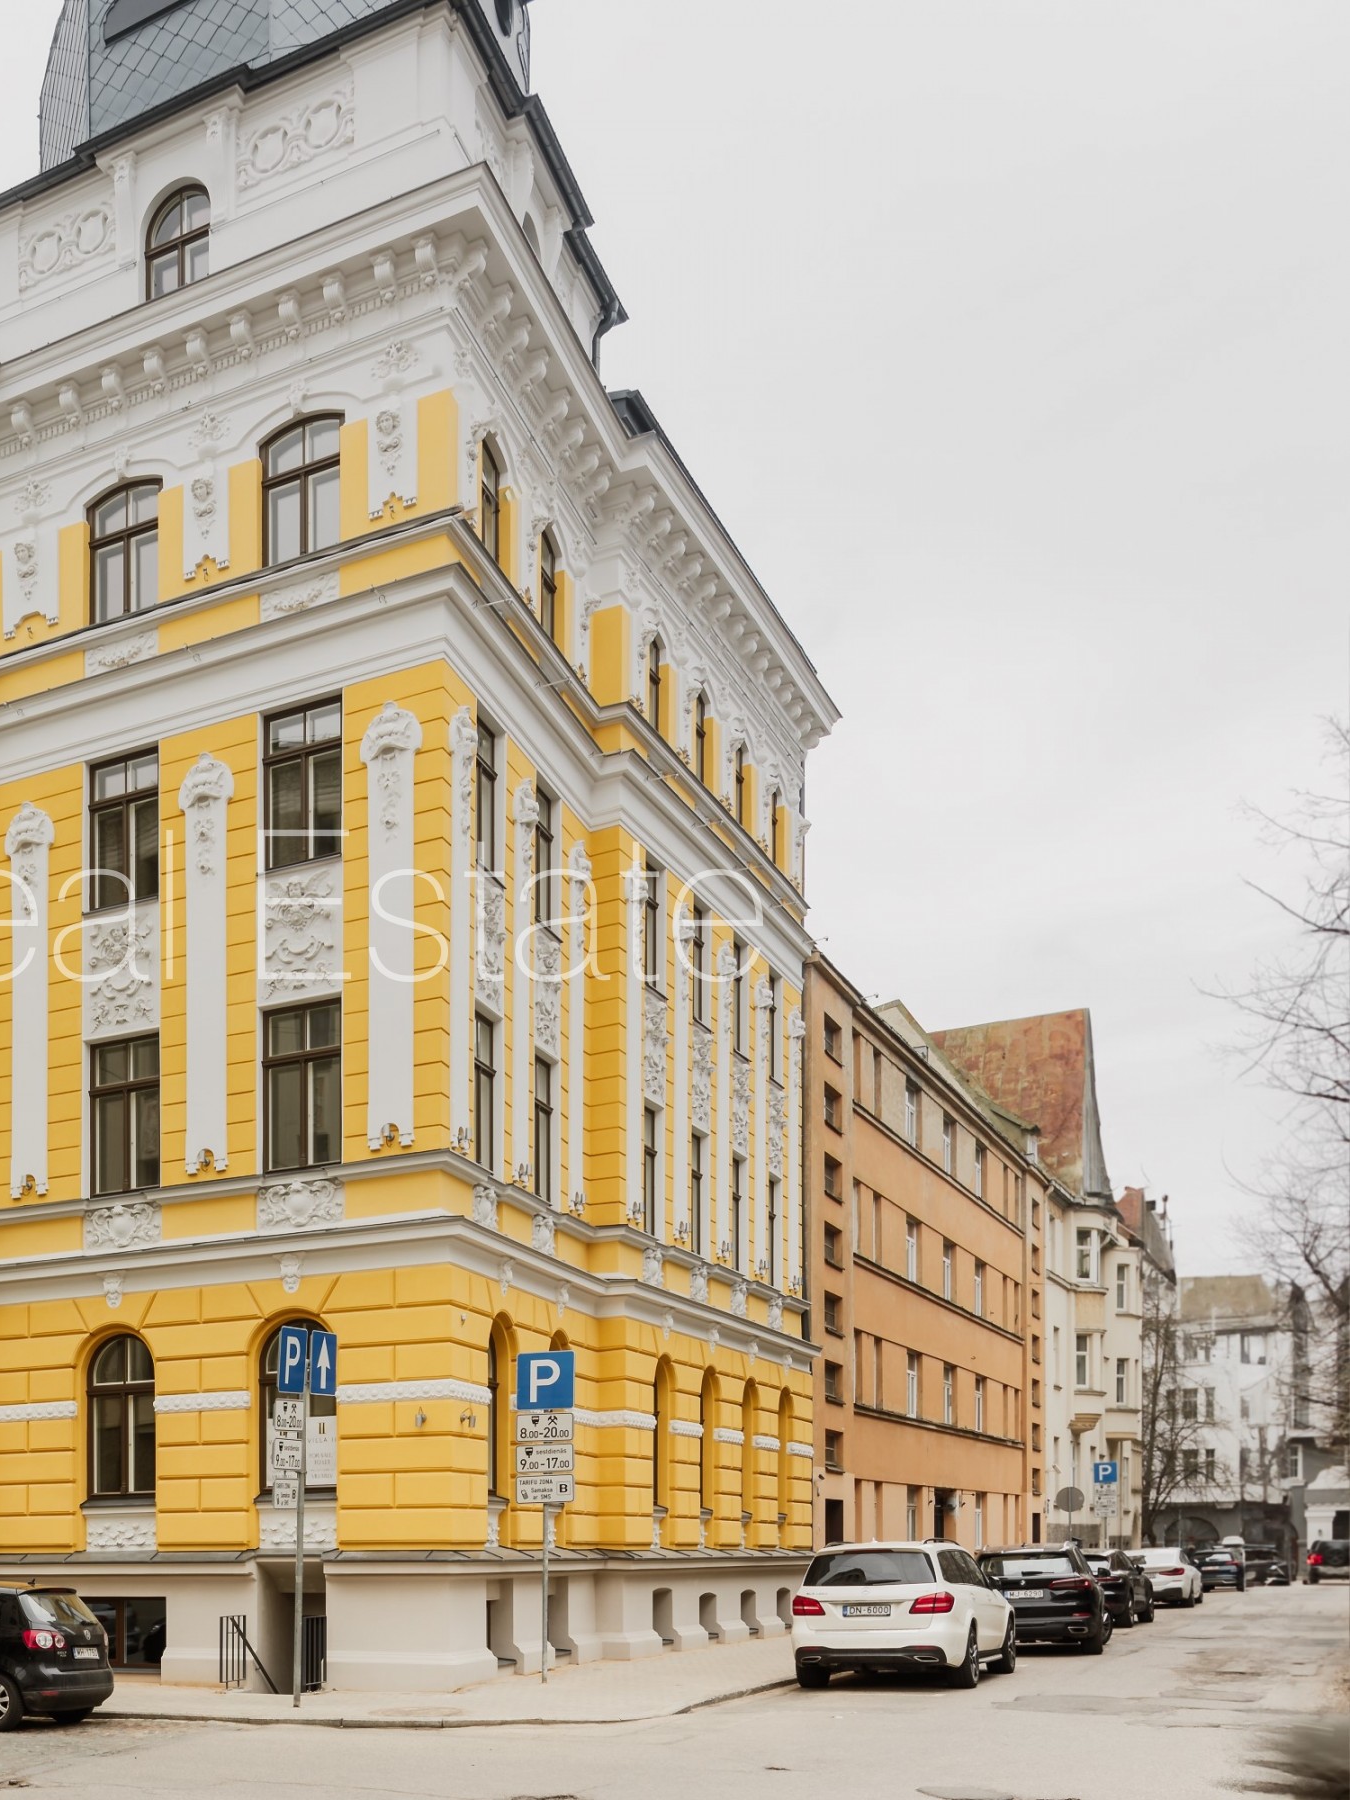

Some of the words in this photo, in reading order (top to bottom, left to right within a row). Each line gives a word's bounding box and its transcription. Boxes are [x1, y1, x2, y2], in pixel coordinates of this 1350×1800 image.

[284, 1335, 301, 1384] P
[530, 1359, 561, 1403] P
[1099, 1464, 1112, 1481] P
[559, 1483, 568, 1493] B
